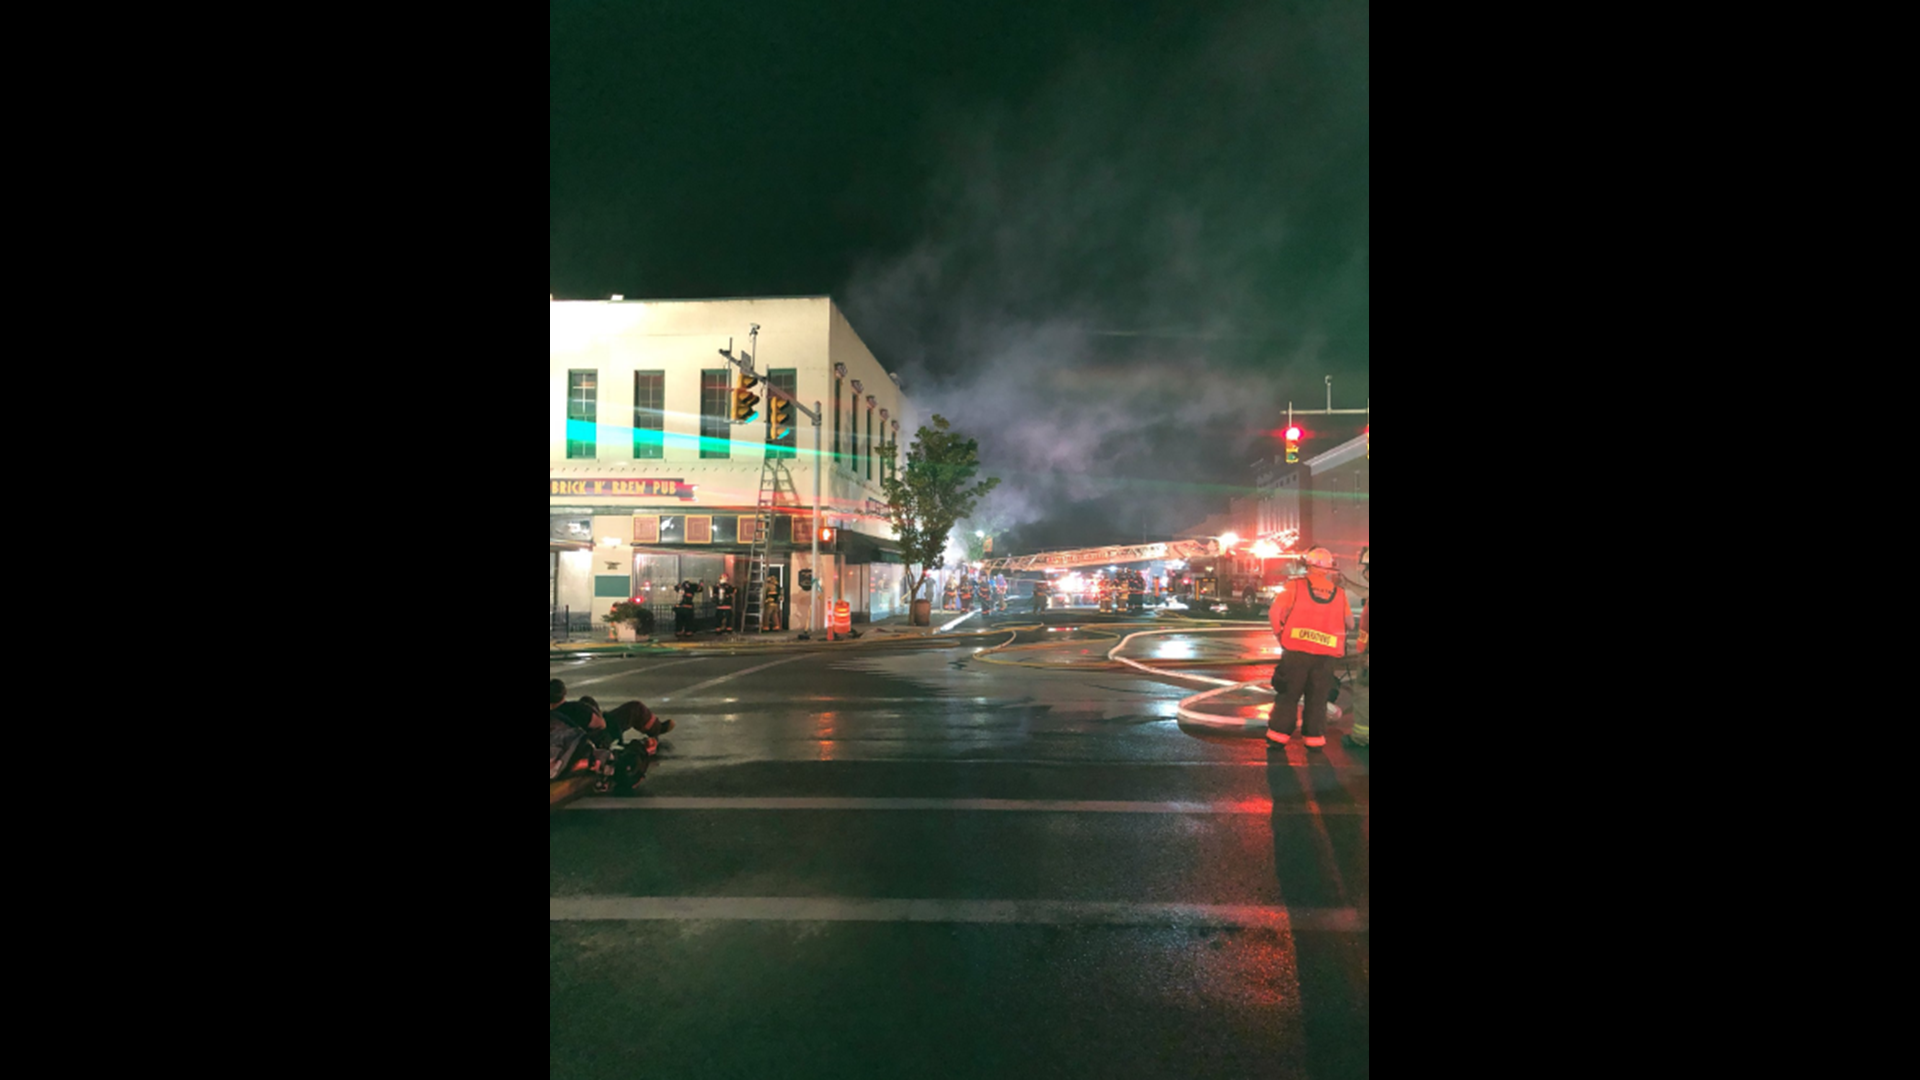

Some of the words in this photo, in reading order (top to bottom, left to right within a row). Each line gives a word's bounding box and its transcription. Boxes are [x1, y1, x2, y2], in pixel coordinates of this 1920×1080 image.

[551, 481, 586, 494] BRICK
[612, 481, 646, 494] BREW
[653, 481, 676, 494] PUB
